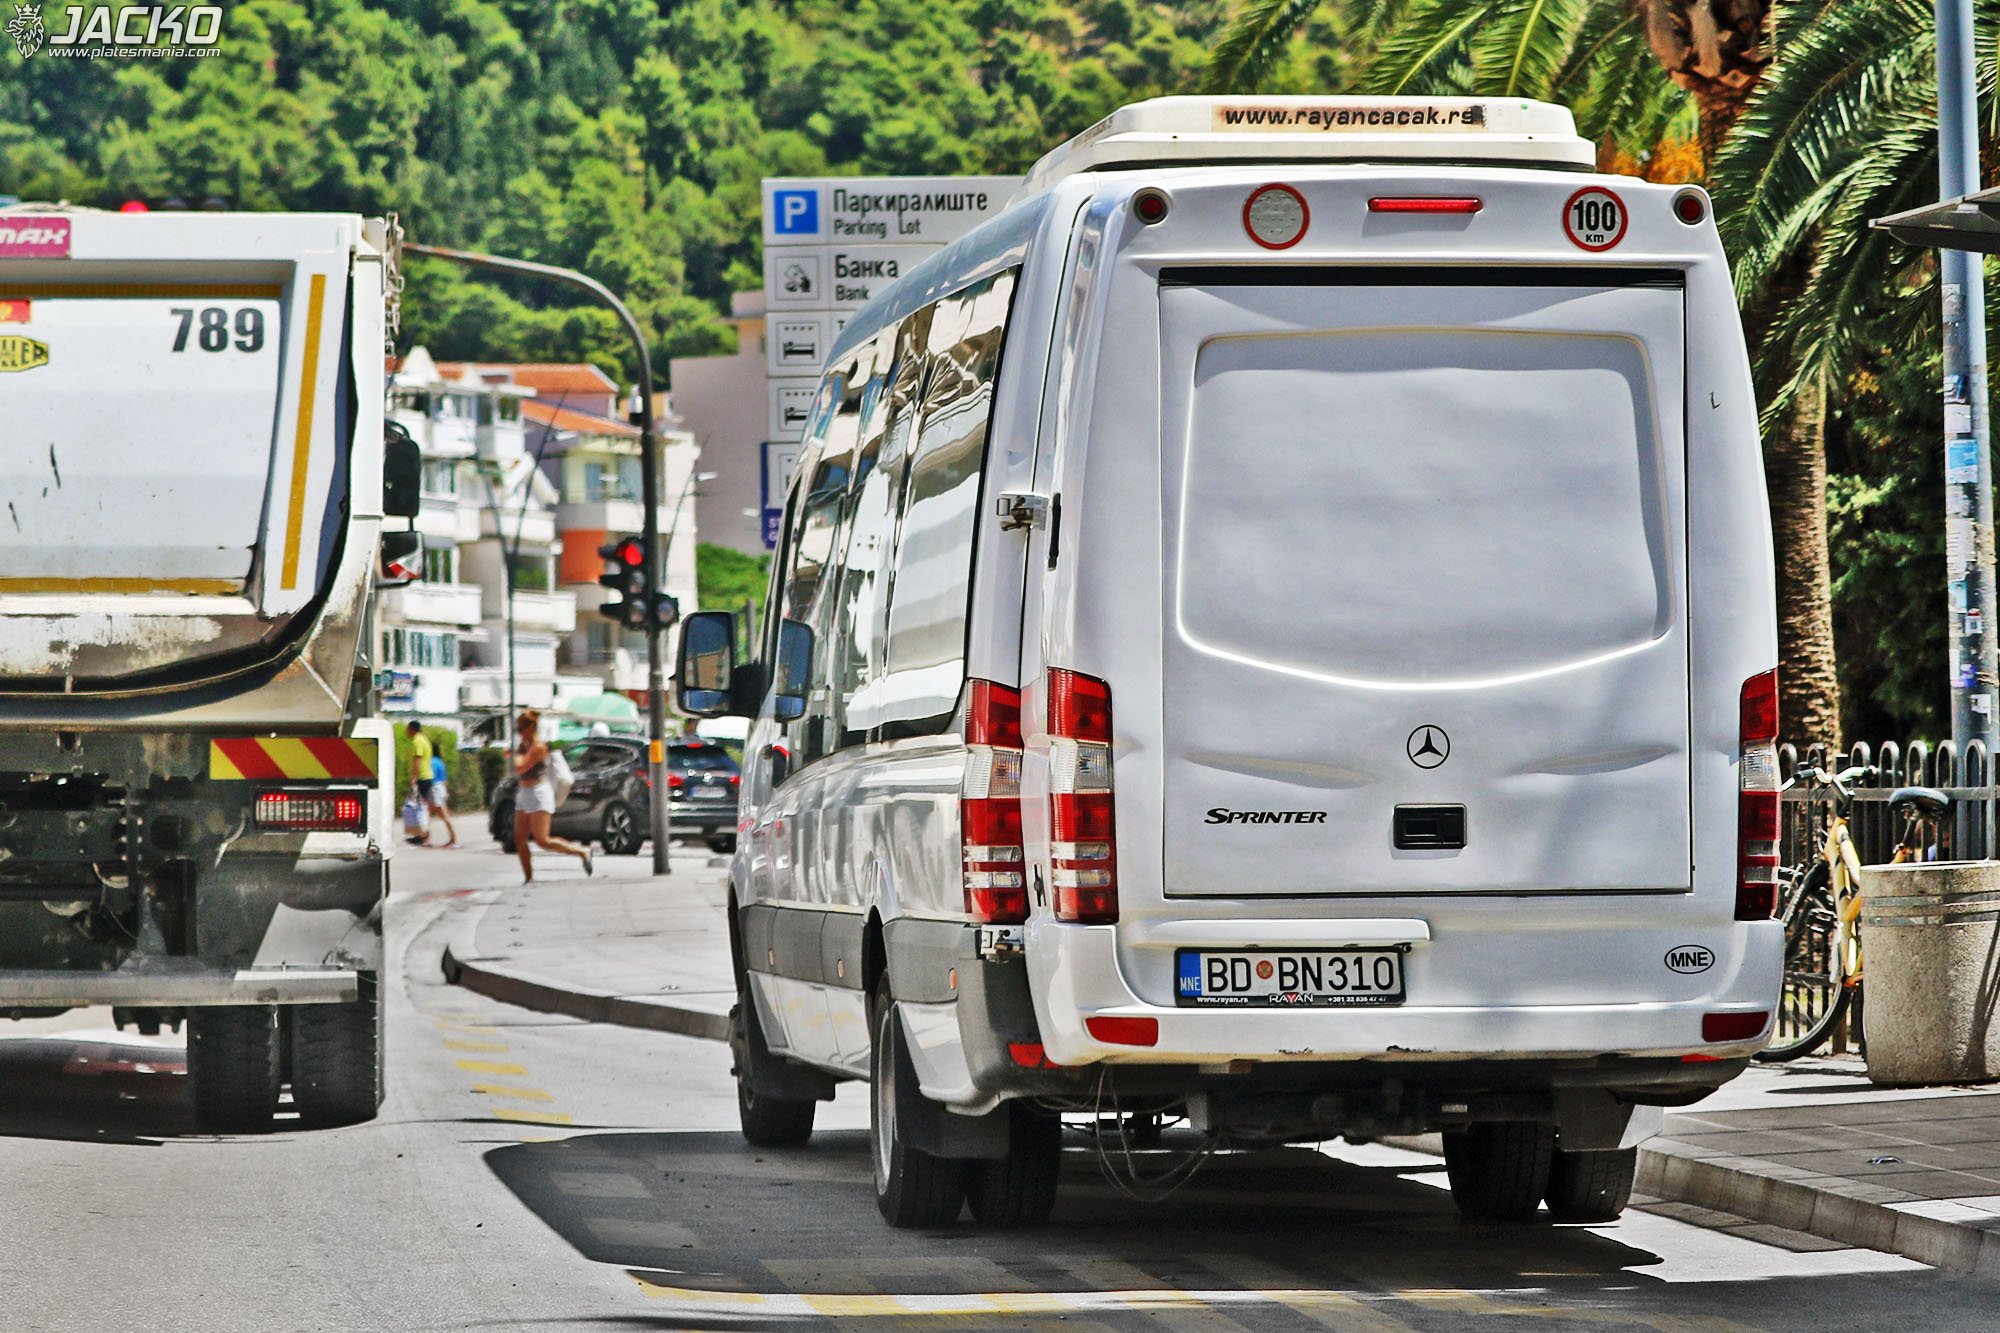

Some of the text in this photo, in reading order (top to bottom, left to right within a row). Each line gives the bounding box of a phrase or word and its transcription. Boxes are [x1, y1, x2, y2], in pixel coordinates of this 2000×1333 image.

[784, 196, 807, 229] P
[834, 189, 987, 217] Паркиралиште
[1573, 200, 1616, 231] 100
[834, 219, 921, 239] Parking Lot
[835, 255, 898, 279] Банка
[835, 285, 869, 301] Bank
[170, 308, 264, 352] 789
[1671, 952, 1709, 967] MNE
[1180, 976, 1200, 991] MNE
[1207, 957, 1394, 992] BD BN310
[1269, 993, 1314, 1003] RAYAN
